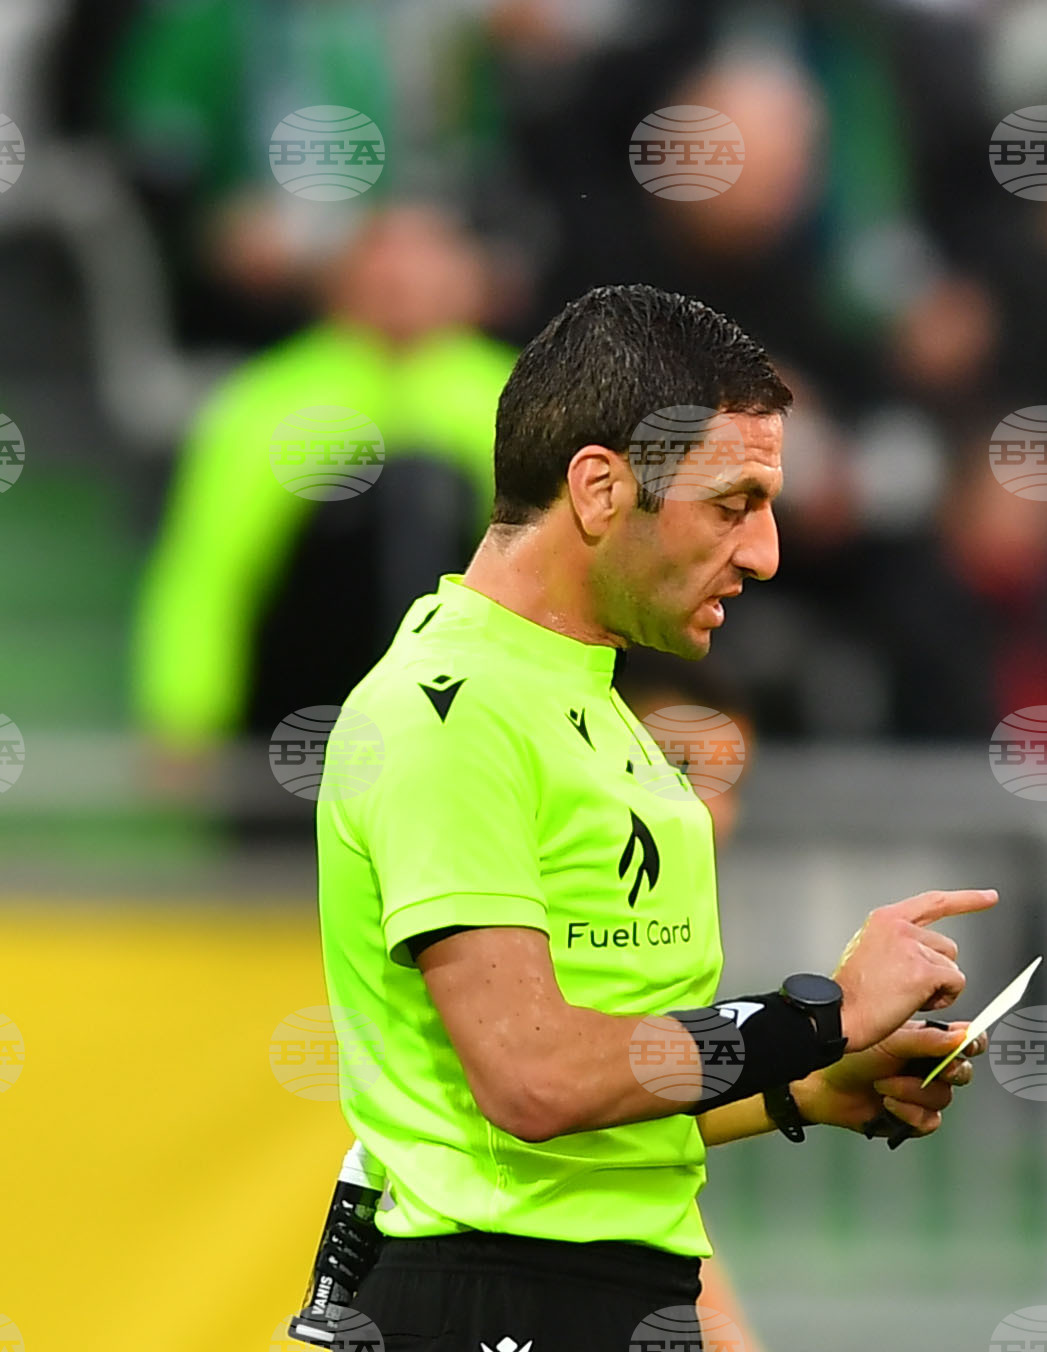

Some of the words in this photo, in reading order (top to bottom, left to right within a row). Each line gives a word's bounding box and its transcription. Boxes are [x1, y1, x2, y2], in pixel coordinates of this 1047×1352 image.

[567, 921, 640, 949] Fuel
[646, 916, 691, 946] Card
[311, 1275, 333, 1315] VANIS
